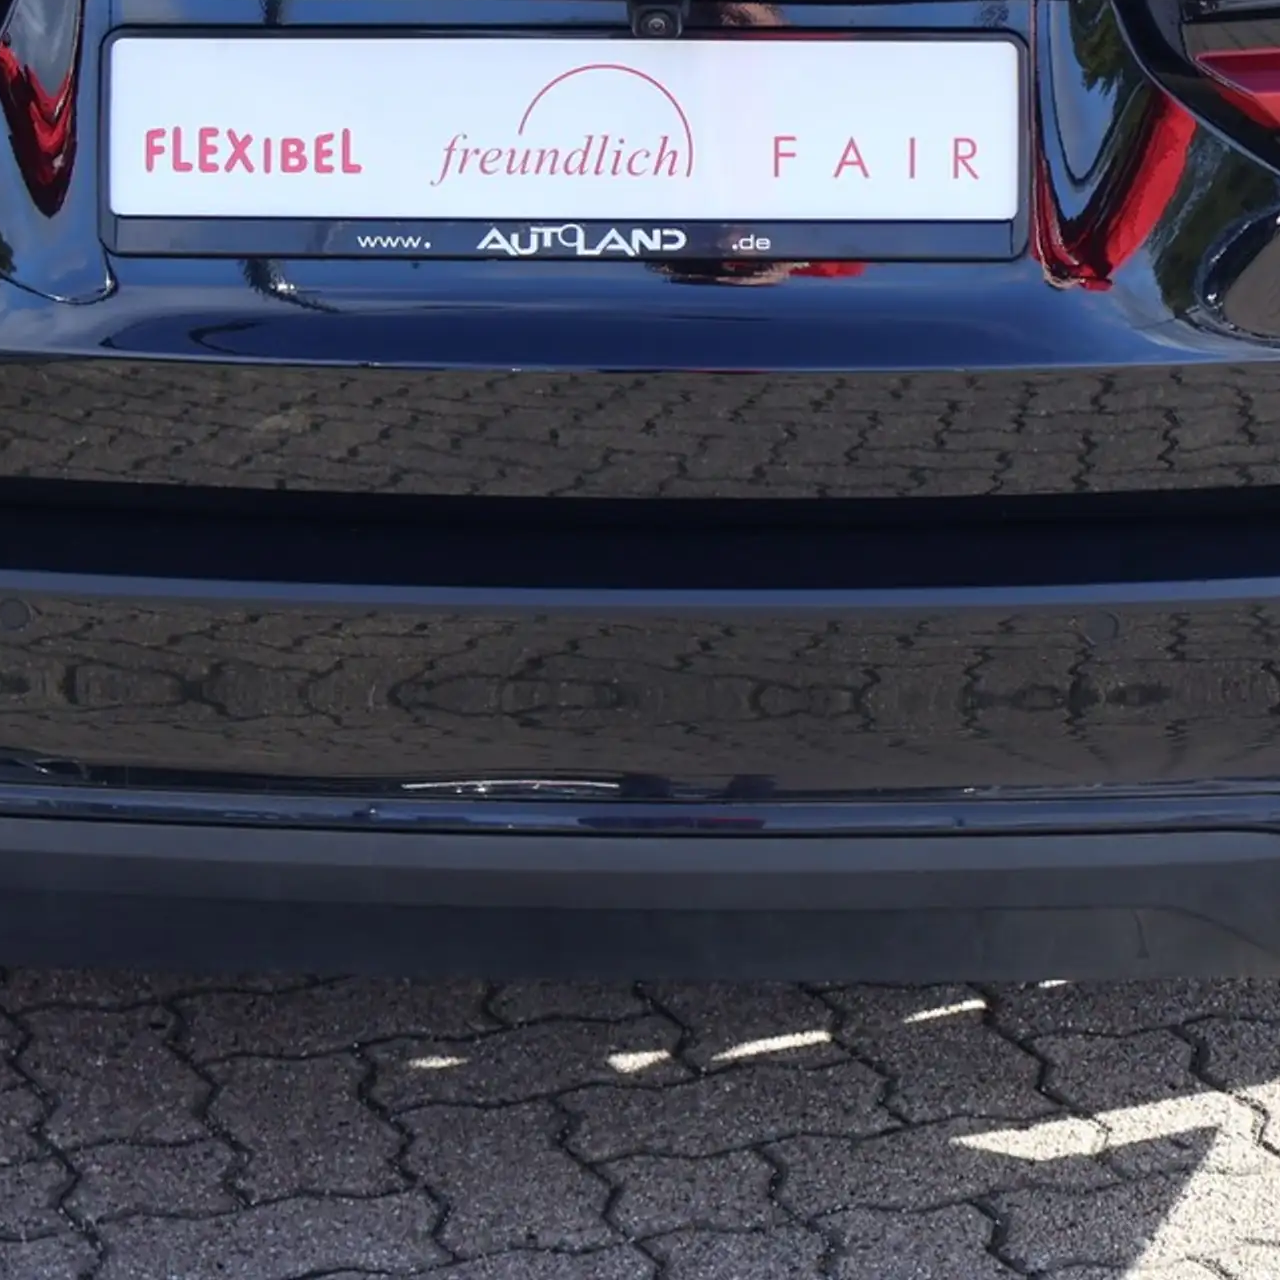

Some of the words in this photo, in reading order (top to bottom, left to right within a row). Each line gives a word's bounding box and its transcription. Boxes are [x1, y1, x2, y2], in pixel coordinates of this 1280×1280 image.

[145, 126, 363, 174] FLEXIBEL
[430, 132, 679, 187] freundlich
[773, 136, 980, 180] FAIR
[476, 224, 687, 257] AUTOLAND
